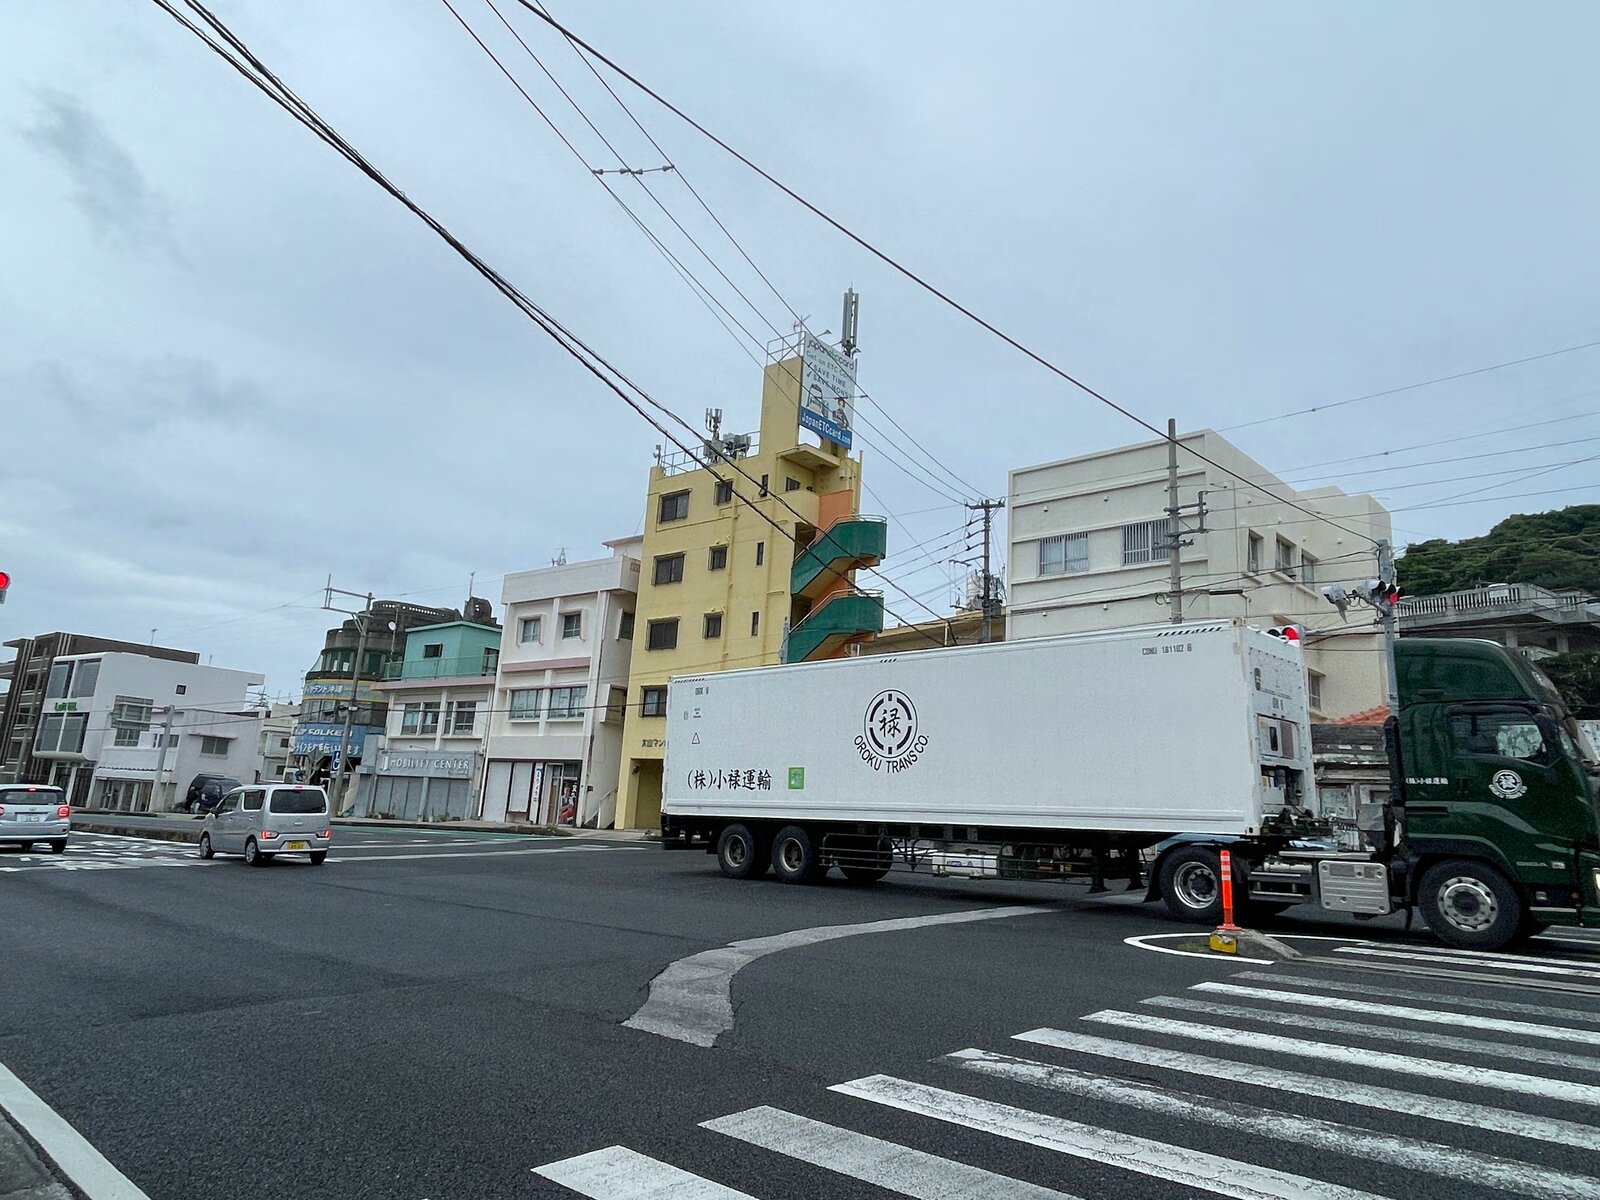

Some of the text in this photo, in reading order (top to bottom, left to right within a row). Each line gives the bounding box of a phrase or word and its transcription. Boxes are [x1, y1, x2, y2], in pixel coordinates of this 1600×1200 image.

[813, 364, 847, 388] SAVE TIME
[827, 361, 838, 373] ETC
[854, 735, 882, 771] OROKU
[886, 750, 918, 773] TRANS
[390, 759, 469, 769] MOBILITY CENTER
